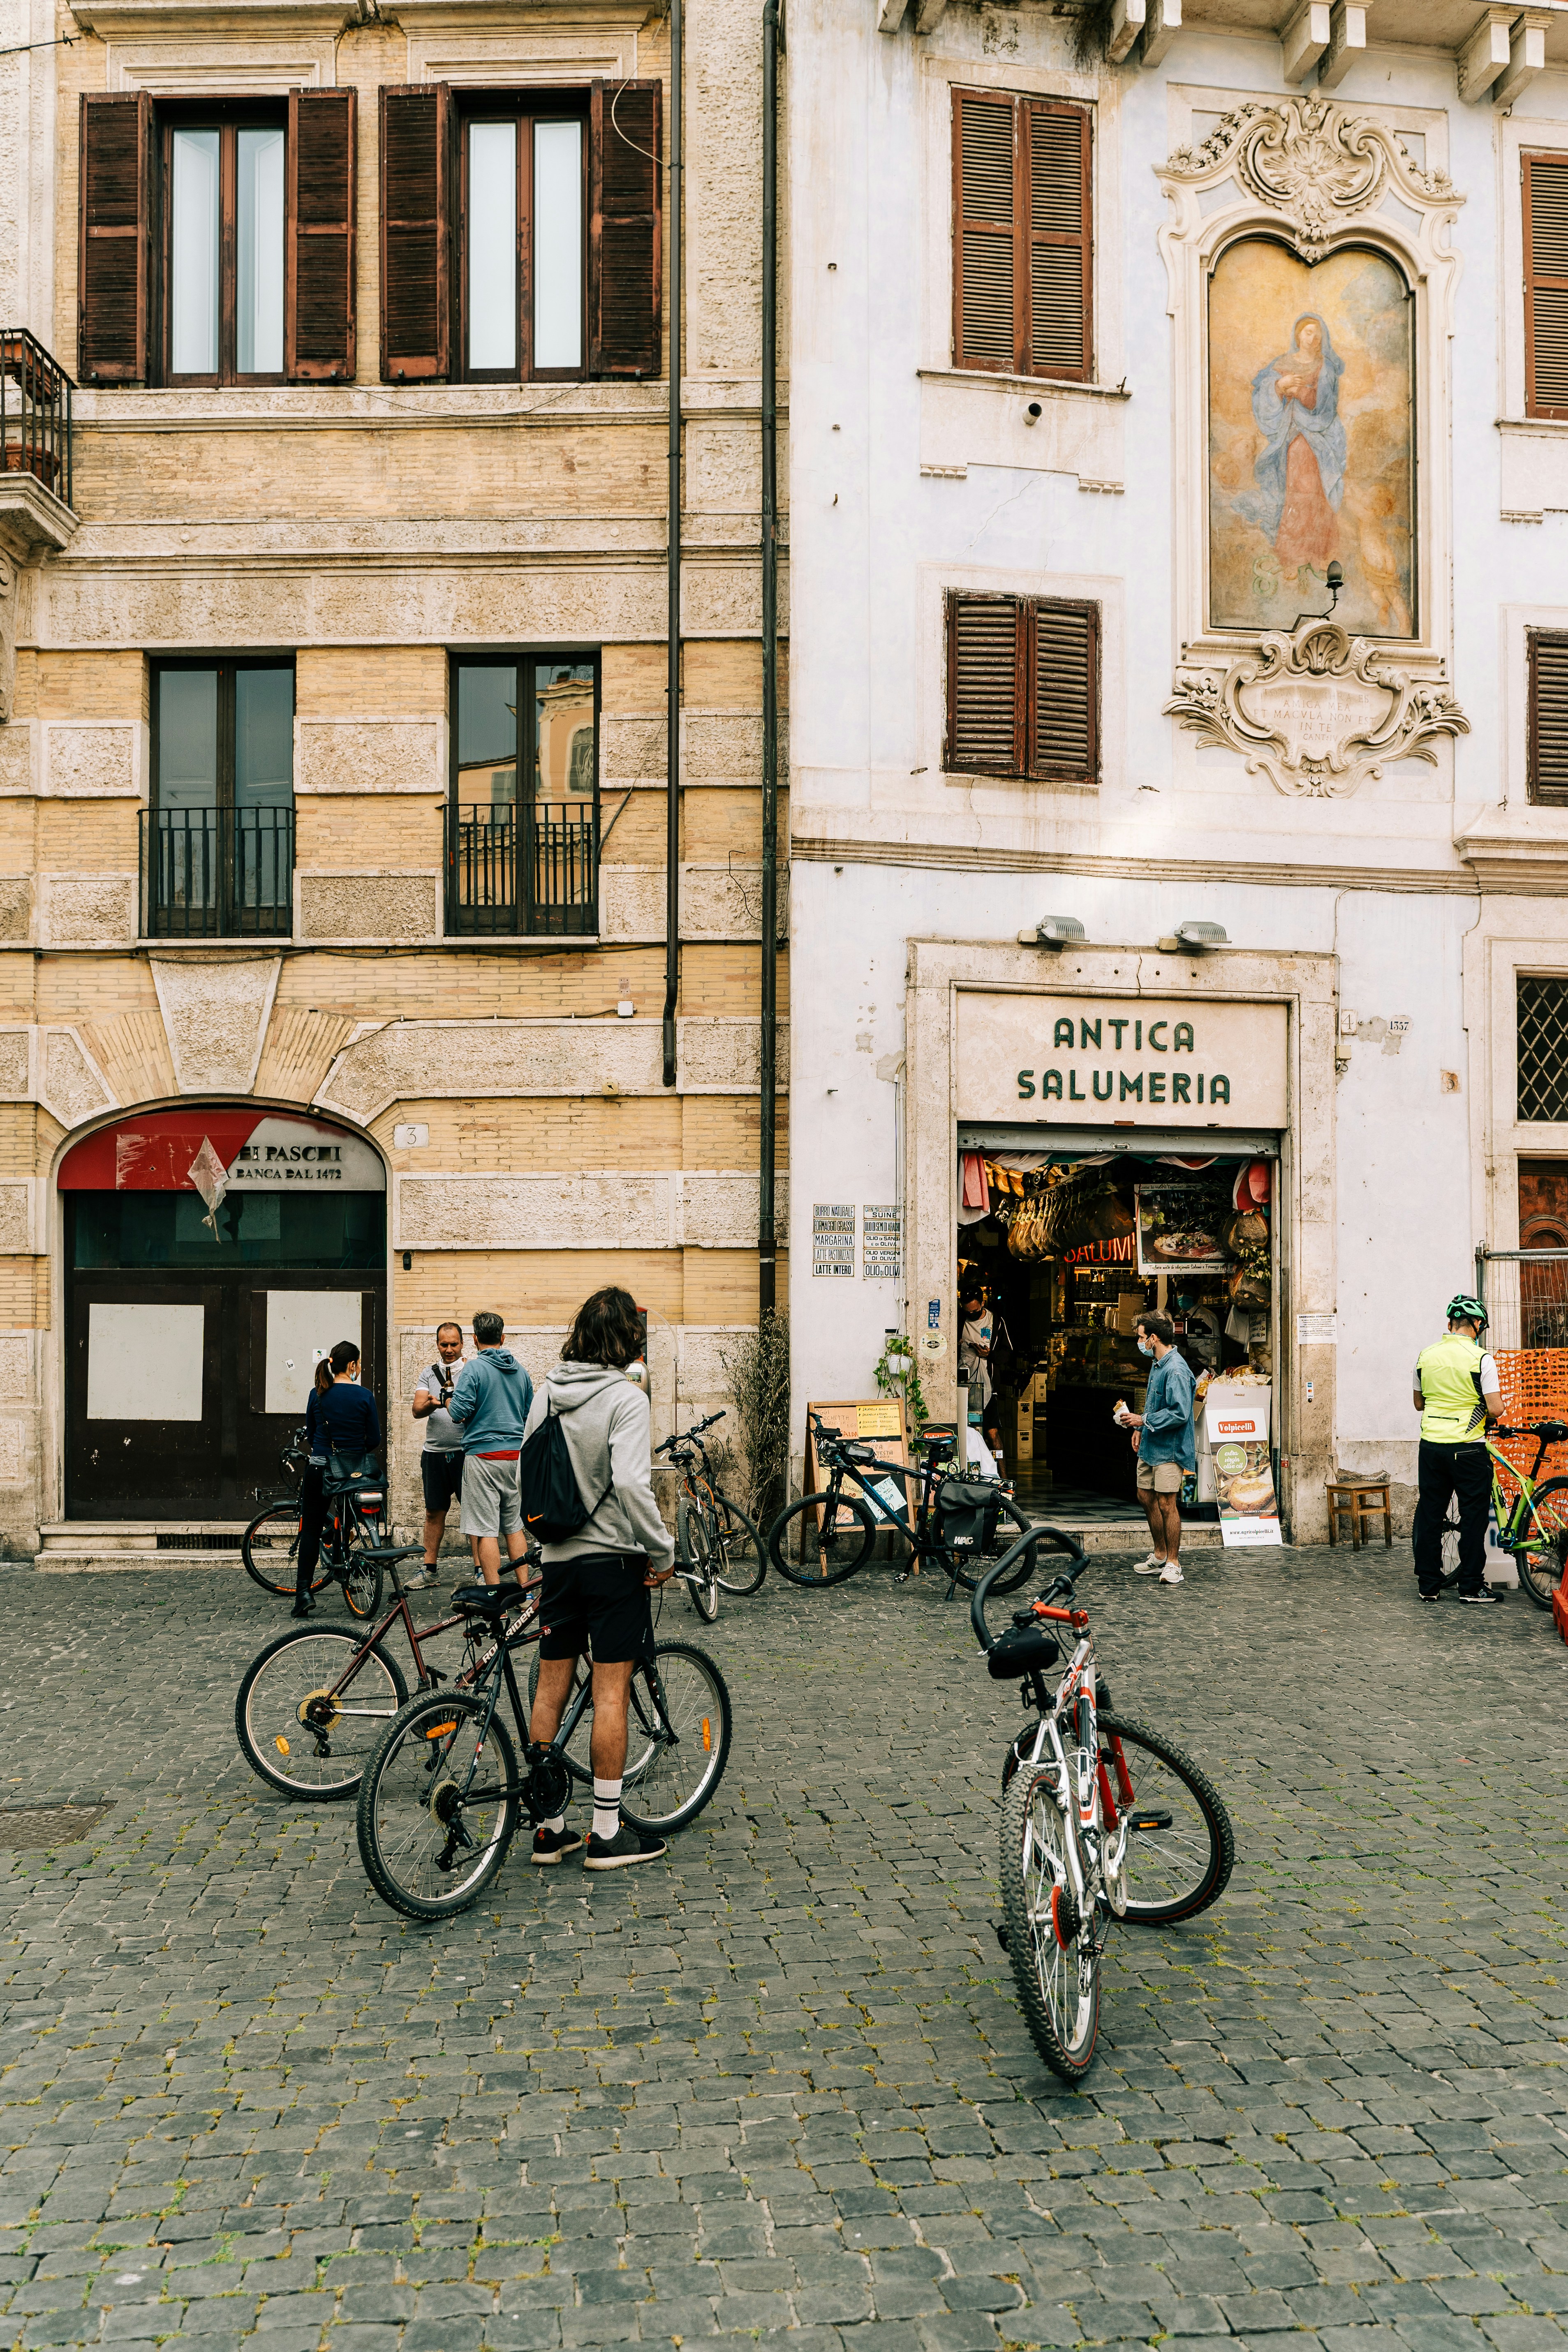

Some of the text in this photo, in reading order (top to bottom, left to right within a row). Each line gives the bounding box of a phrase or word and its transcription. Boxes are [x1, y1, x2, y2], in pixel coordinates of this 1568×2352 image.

[1358, 695, 1369, 703] ES
[1283, 700, 1351, 712] AMICA MEA
[1254, 709, 1377, 725] ET MACVLA NON EST
[1300, 722, 1332, 732] IN TE
[1341, 1014, 1354, 1030] 4
[1390, 1021, 1409, 1031] 1357
[1054, 1017, 1194, 1052] ANTICA
[1018, 1069, 1230, 1104] SALUMERIA
[406, 1127, 416, 1145] 3
[236, 1168, 282, 1179] BANCA
[285, 1168, 313, 1179] DAL
[316, 1168, 342, 1179] 1472
[815, 1206, 853, 1217] BURRO NATURALE
[814, 1220, 854, 1232] FORMAGGIO GRASSO
[815, 1235, 853, 1246] MARGARINA
[814, 1249, 854, 1260] LATTE PASTORIZZATO
[816, 1265, 851, 1274] LATTE INTERO
[865, 1265, 879, 1276] OLIO
[884, 1265, 900, 1277] OLIV
[1219, 1422, 1252, 1433] Volpicelli
[1224, 1457, 1240, 1465] virgin
[954, 1536, 974, 1545] WAG
[442, 1615, 458, 1626] 5.0
